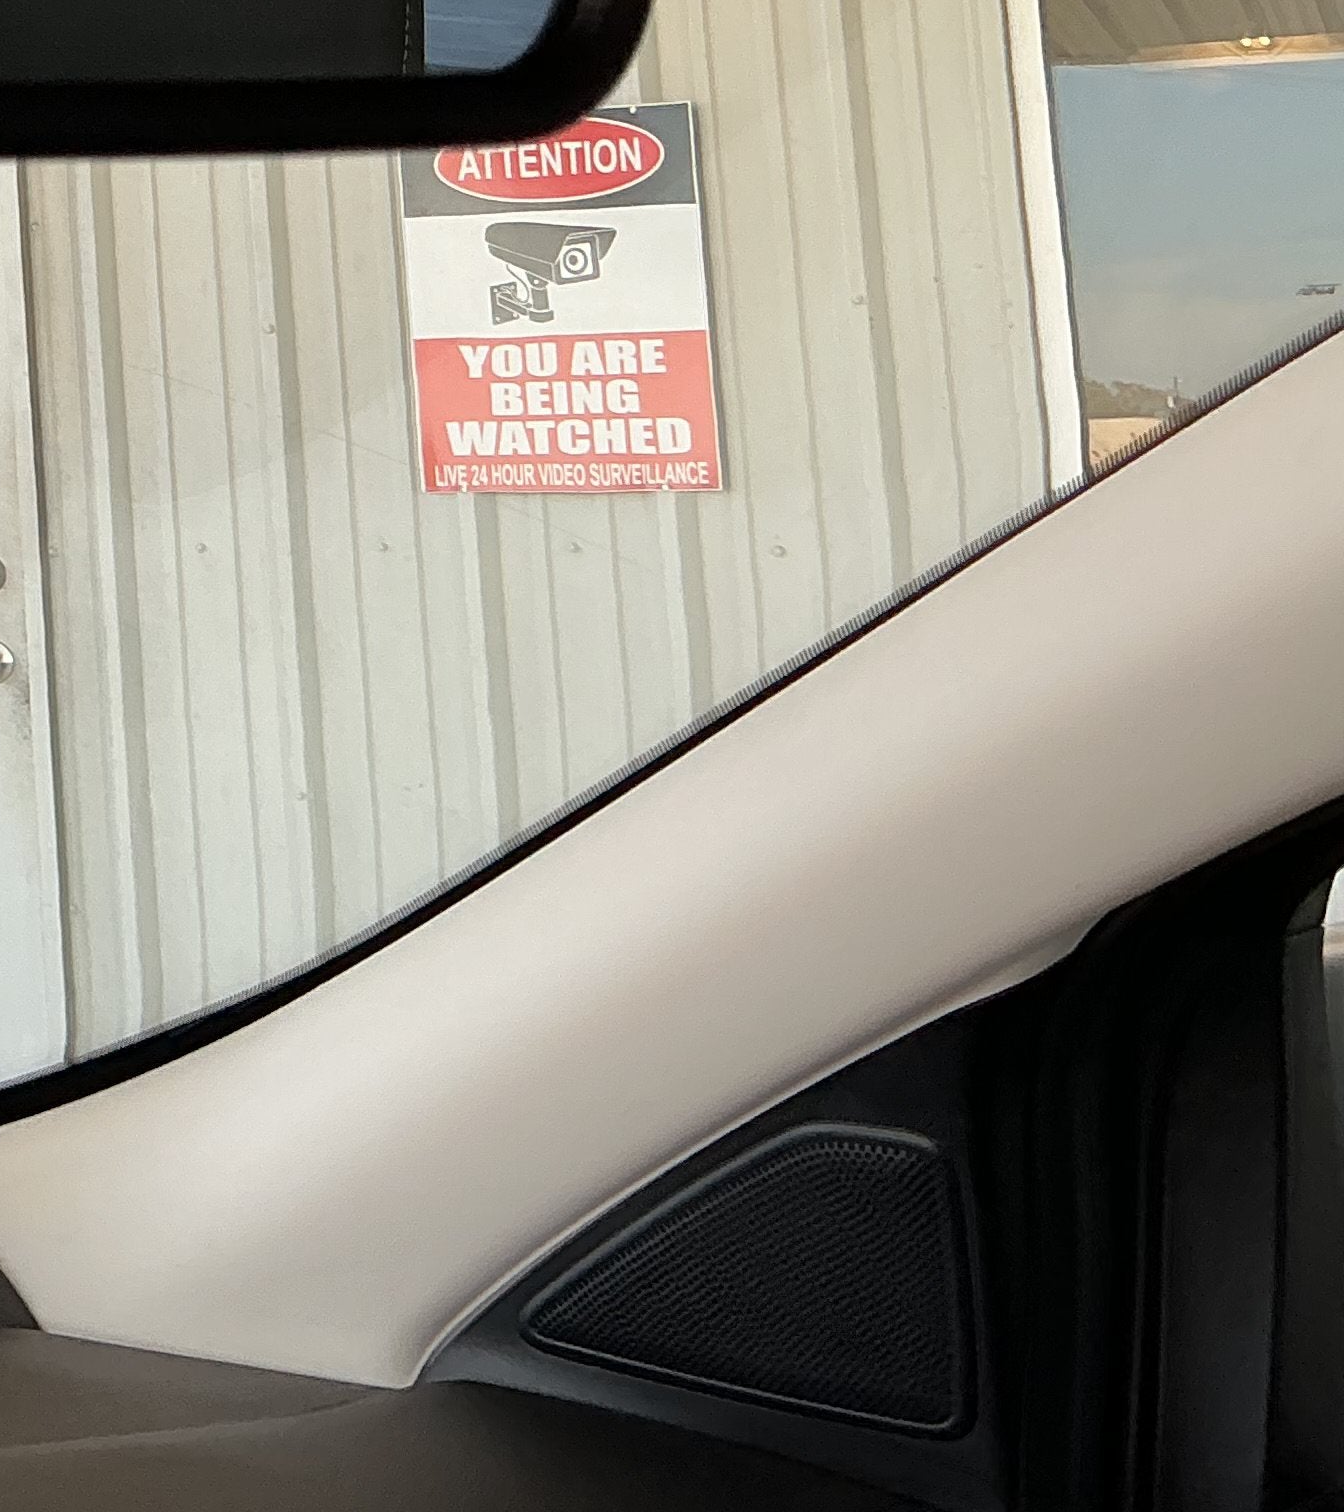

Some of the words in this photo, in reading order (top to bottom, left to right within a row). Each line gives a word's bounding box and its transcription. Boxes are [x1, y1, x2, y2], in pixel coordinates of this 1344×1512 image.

[457, 137, 643, 182] ATTENTION
[458, 341, 558, 379] YOU
[570, 338, 667, 376] ARE
[489, 378, 641, 417] BEING
[445, 417, 693, 457] WATCHED
[434, 465, 468, 487] LIVE
[471, 464, 489, 486] 24
[491, 463, 536, 486] HOUR
[537, 463, 586, 486] VIDEO
[589, 461, 710, 486] SURVEILLANCE
